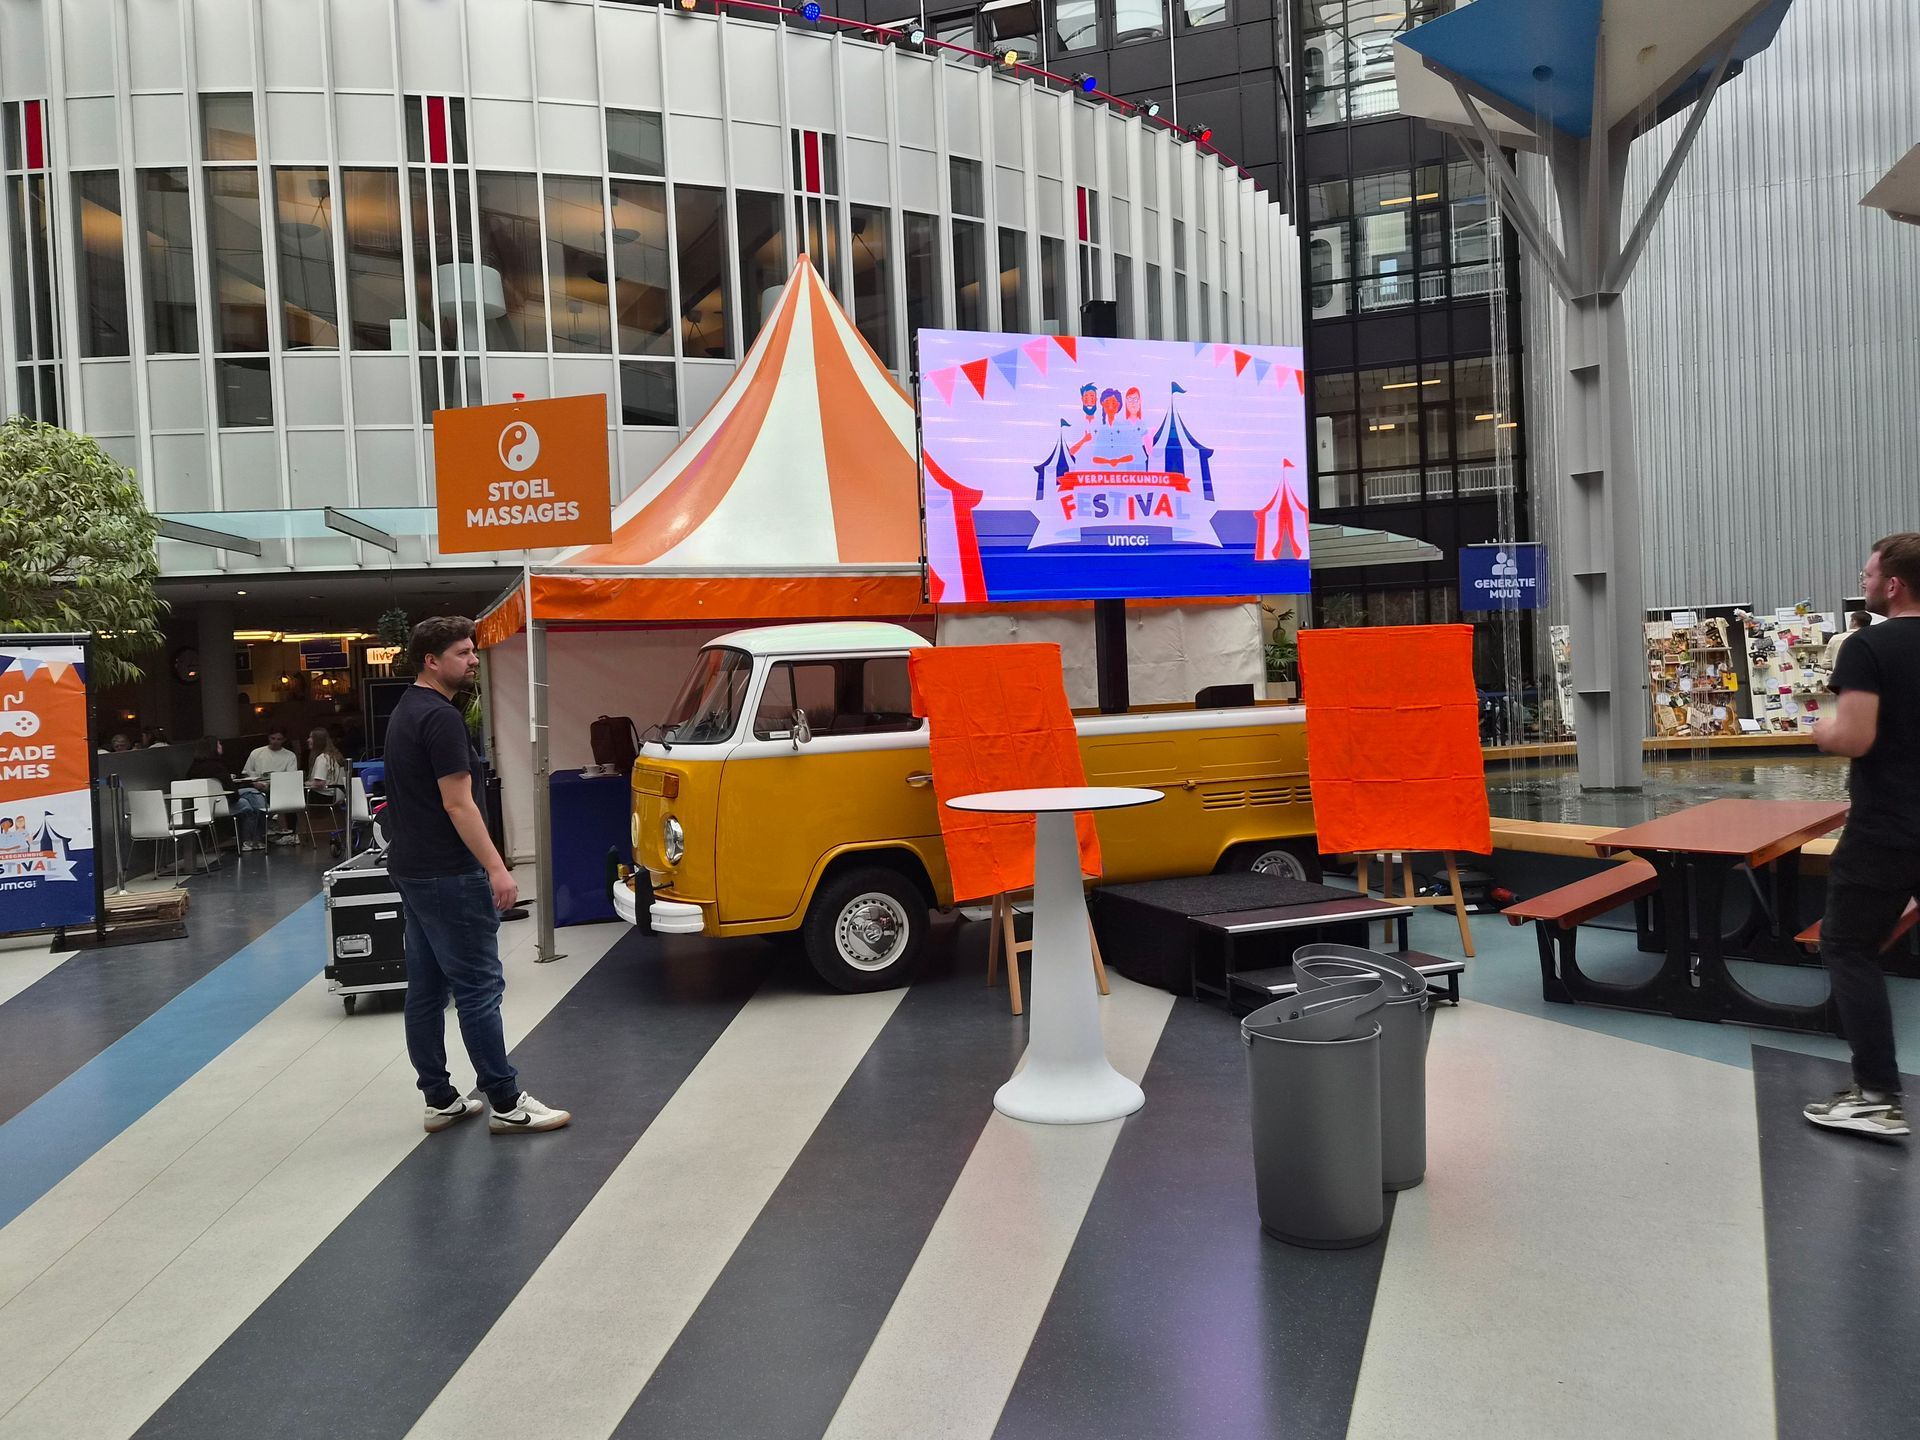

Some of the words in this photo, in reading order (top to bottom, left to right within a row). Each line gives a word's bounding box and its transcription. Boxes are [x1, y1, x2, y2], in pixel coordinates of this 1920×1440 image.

[1077, 474, 1170, 485] VERPLEEGKUNDIG
[488, 478, 555, 502] STOEL
[466, 501, 580, 528] MASSAGES
[1060, 492, 1190, 521] FESTIVAL
[1474, 578, 1536, 589] GENERATIE
[1489, 589, 1522, 599] MUUR
[0, 763, 50, 781] MES
